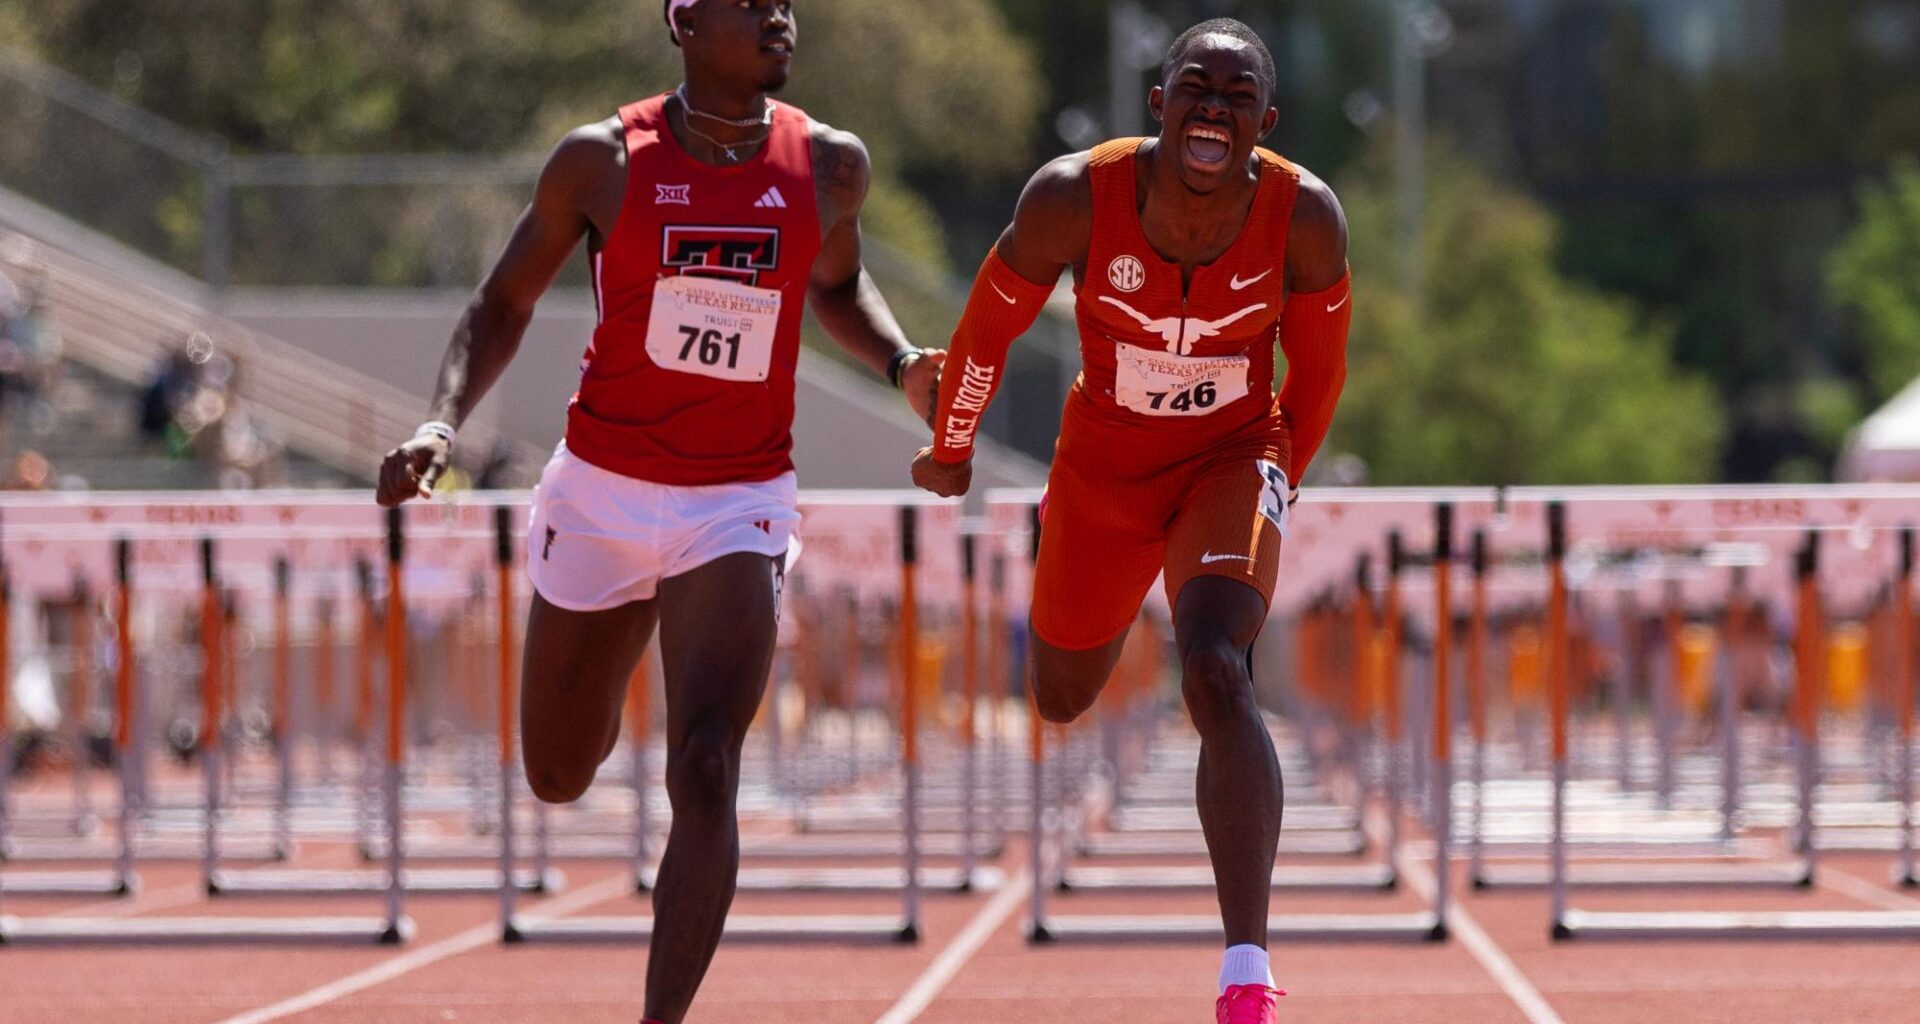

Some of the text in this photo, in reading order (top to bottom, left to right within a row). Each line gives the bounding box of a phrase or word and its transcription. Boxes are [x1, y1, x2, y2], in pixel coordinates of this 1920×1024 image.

[1111, 256, 1142, 290] SEC
[686, 293, 728, 310] TEXAS
[704, 314, 739, 328] TRUIST
[678, 325, 741, 369] 761
[951, 355, 995, 414] HOOK
[1148, 361, 1246, 378] TEXAS RELAYS
[1170, 374, 1206, 390] TRUIST
[1146, 381, 1217, 412] 746
[1266, 464, 1286, 524] 5
